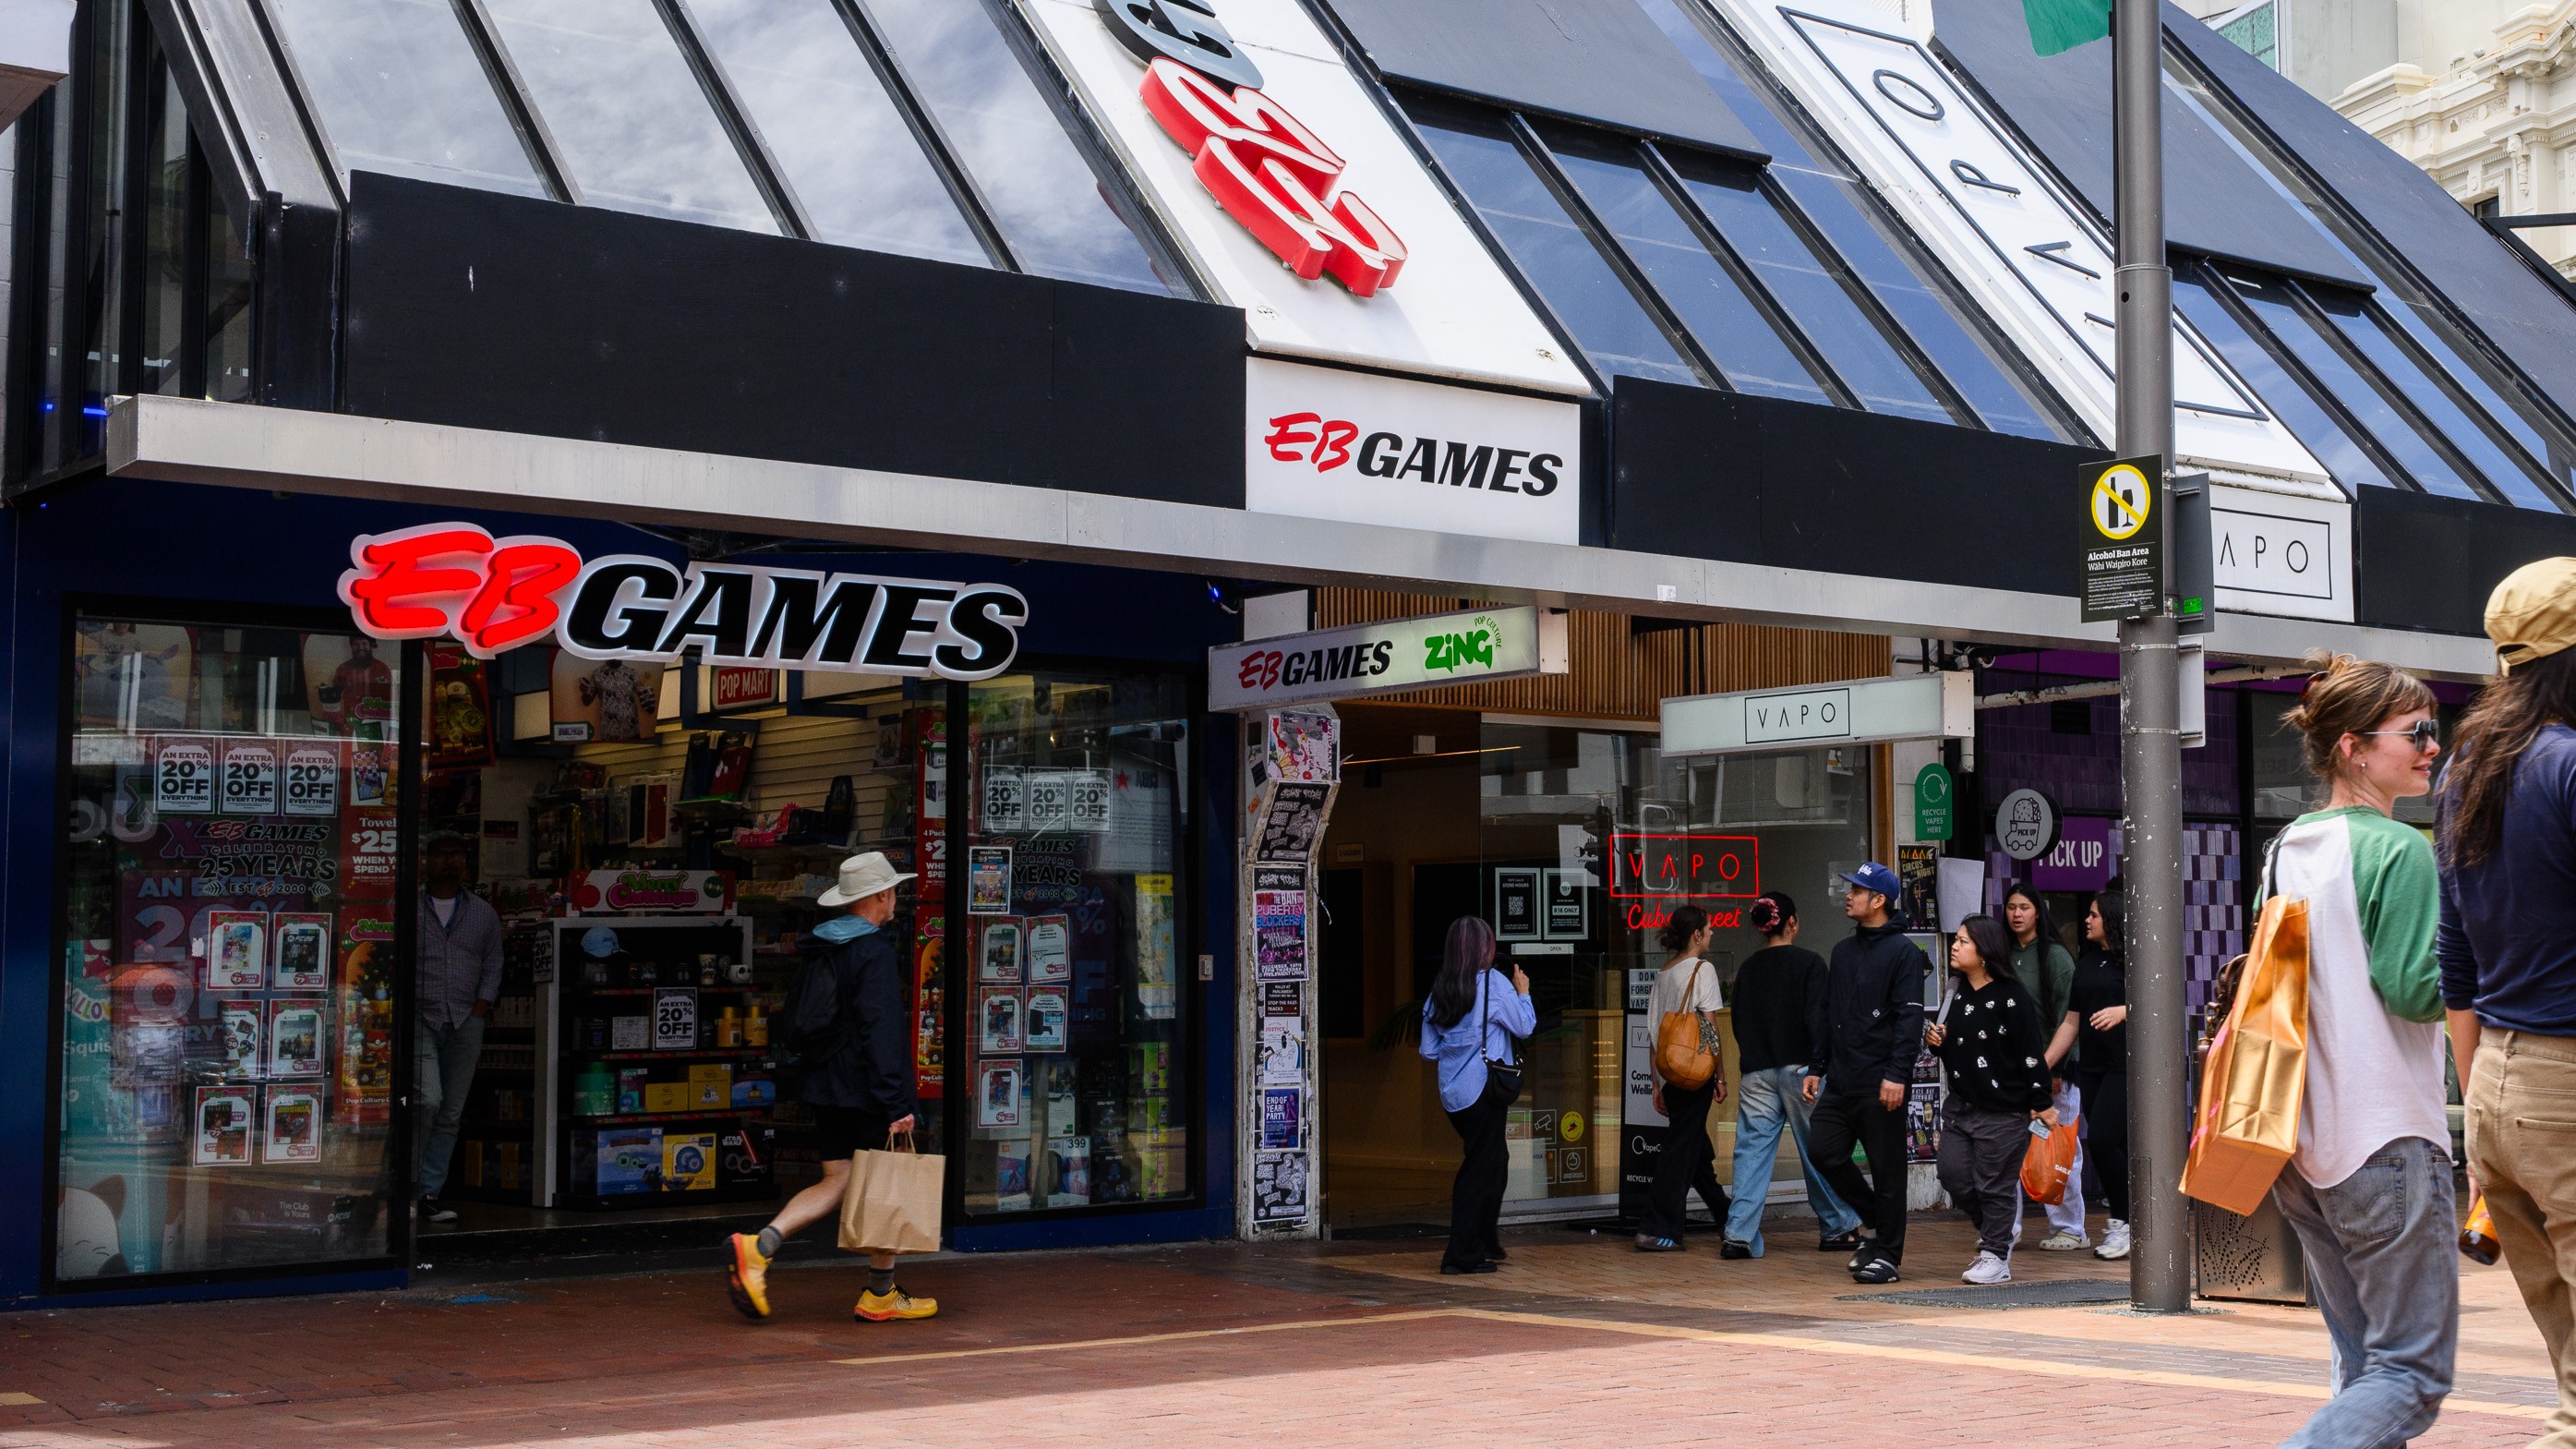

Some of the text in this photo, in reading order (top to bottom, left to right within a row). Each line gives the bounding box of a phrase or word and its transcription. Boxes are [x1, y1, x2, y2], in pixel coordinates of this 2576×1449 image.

[1357, 430, 1564, 497] GAMES
[2088, 548, 2149, 561] Alcohol Ban Area
[2220, 531, 2308, 574] APO
[2105, 559, 2131, 571] Waipiro
[2132, 558, 2148, 566] Kore
[567, 560, 1028, 674] GAMES
[1475, 615, 1502, 650] POP CULTURE
[1282, 640, 1393, 686] GAMES
[720, 670, 771, 700] POP MART
[1757, 702, 1836, 729] VAPO
[162, 760, 210, 778] 20%
[227, 762, 273, 779] 20%
[290, 765, 333, 782] 20%
[161, 779, 210, 794] OFF
[226, 780, 273, 796] OFF
[289, 782, 333, 798] OFF
[987, 803, 1021, 815] OFF
[1031, 803, 1065, 817] OFF
[1073, 803, 1108, 817] OFF
[1921, 808, 1946, 816] RECYCLE
[244, 824, 330, 841] GAMES
[351, 830, 397, 853] $25
[1015, 839, 1077, 854] GAMES
[211, 843, 327, 857] CELEBRATING
[924, 839, 946, 860] $2
[2039, 839, 2103, 867] ICK UP
[199, 854, 337, 881] 25 YEARS
[925, 862, 946, 870] WHE
[1013, 855, 1075, 867] EBRATING
[1628, 851, 1741, 880] VAPO
[1902, 860, 1923, 873] CIRCUS
[354, 865, 390, 874] SPEND
[1013, 864, 1080, 887] YEARS
[1916, 866, 1935, 878] NIGHT
[230, 884, 254, 892] EST
[277, 884, 307, 894] 2000
[620, 872, 688, 894] Merry
[608, 884, 697, 906] Christmas
[1039, 890, 1059, 899] 2000
[1281, 892, 1297, 905] BAN
[1257, 905, 1305, 915] PUBERTY
[535, 956, 552, 969] OFF
[1631, 998, 1649, 1008] VAPE
[658, 1007, 692, 1021] 20%
[658, 1022, 692, 1034] OFF
[64, 1038, 112, 1057] Squis
[1266, 1096, 1279, 1105] END
[1266, 1112, 1286, 1120] PARTY
[1067, 1138, 1087, 1149] 399
[1642, 1142, 1661, 1154] VapeC
[2054, 1164, 2071, 1175] DAILY
[1626, 1175, 1646, 1183] RECYCLE
[278, 1201, 309, 1211] The Club
[291, 1211, 311, 1219] Yours
